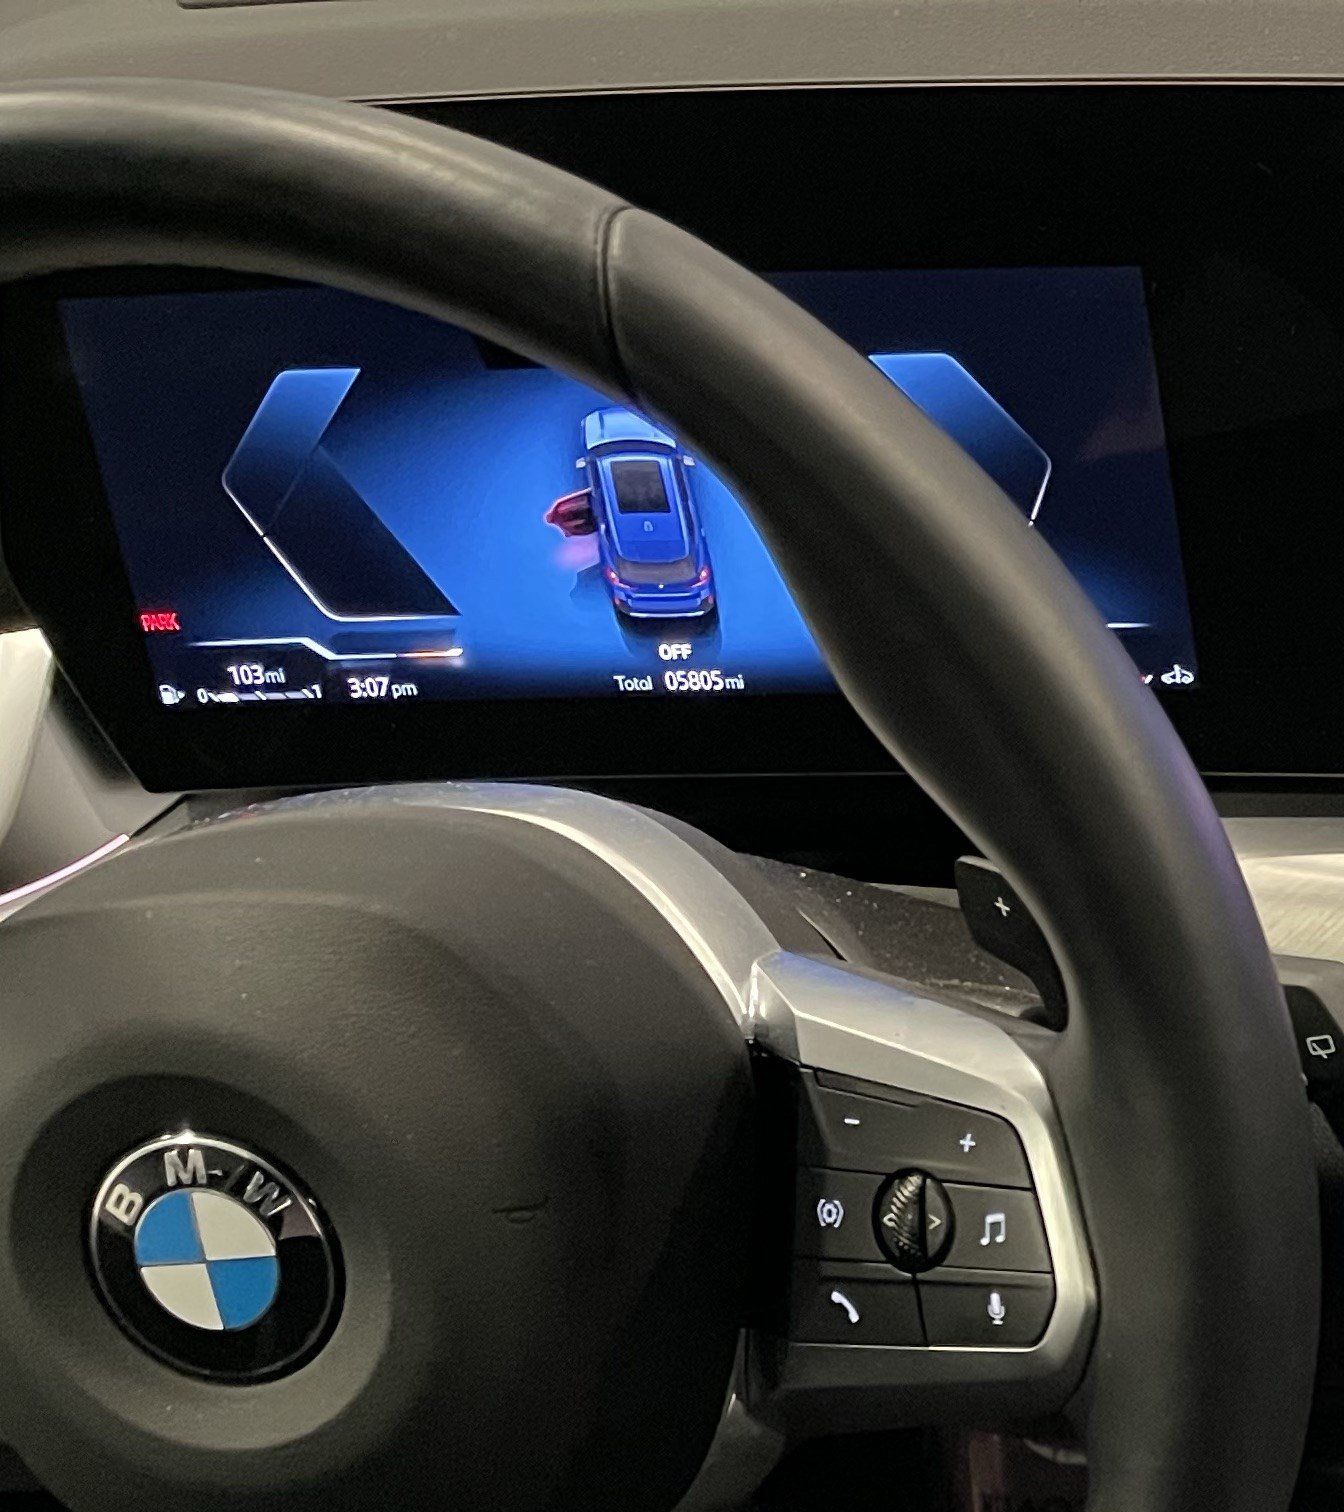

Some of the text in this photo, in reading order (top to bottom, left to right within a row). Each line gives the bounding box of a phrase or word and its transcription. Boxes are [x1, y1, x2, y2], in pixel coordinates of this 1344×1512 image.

[140, 611, 181, 632] PARK
[658, 643, 693, 661] OFF
[347, 676, 418, 700] 3:07 pm
[613, 674, 654, 692] Total
[105, 1148, 293, 1226] BMW
